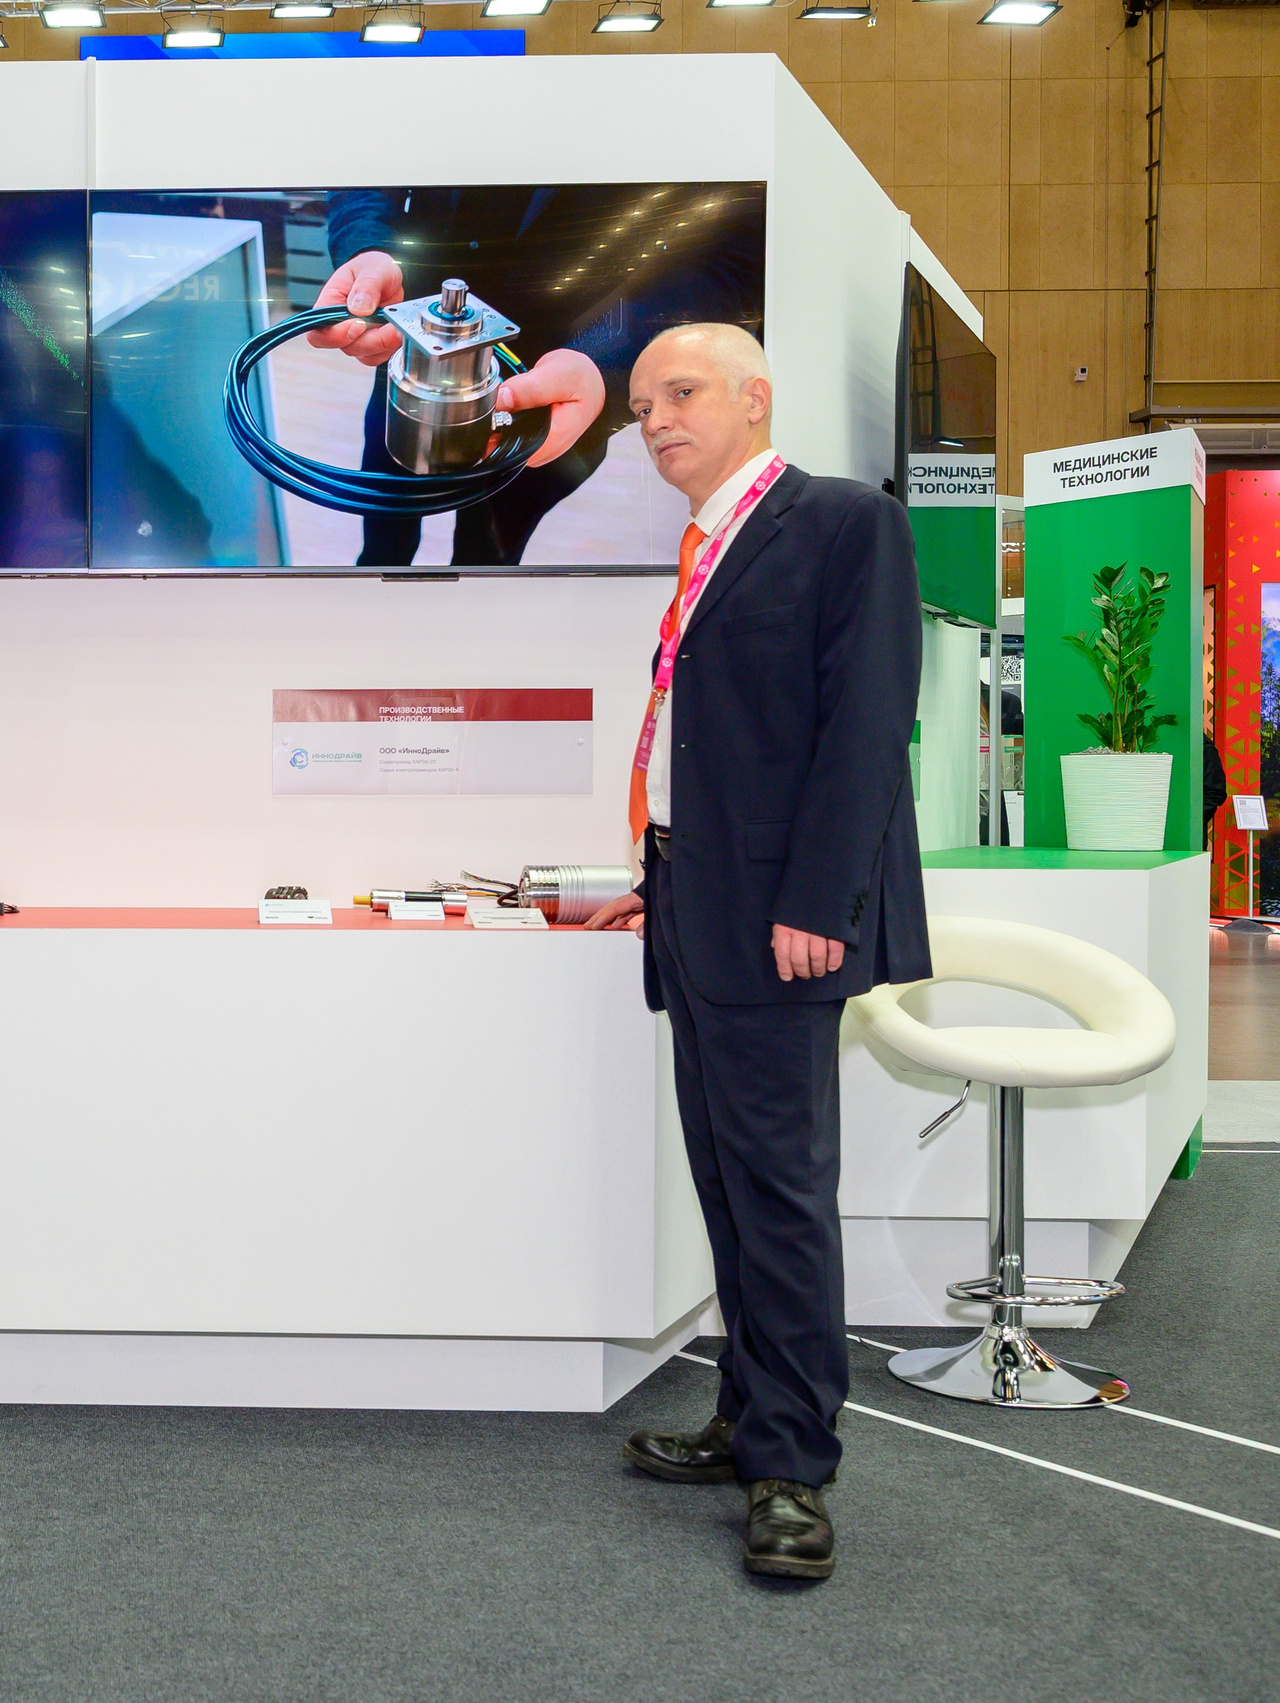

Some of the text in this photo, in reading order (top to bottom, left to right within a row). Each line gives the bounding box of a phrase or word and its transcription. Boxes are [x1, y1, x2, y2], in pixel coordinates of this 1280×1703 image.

[1052, 446, 1158, 473] МЕДИЦИНСКИЕ
[1060, 465, 1150, 489] ТЕХНОЛОГИИ
[379, 706, 464, 714] ПРОИЗВОДСТВЕННЫЕ
[312, 752, 362, 760] ИННОДРАЙВ
